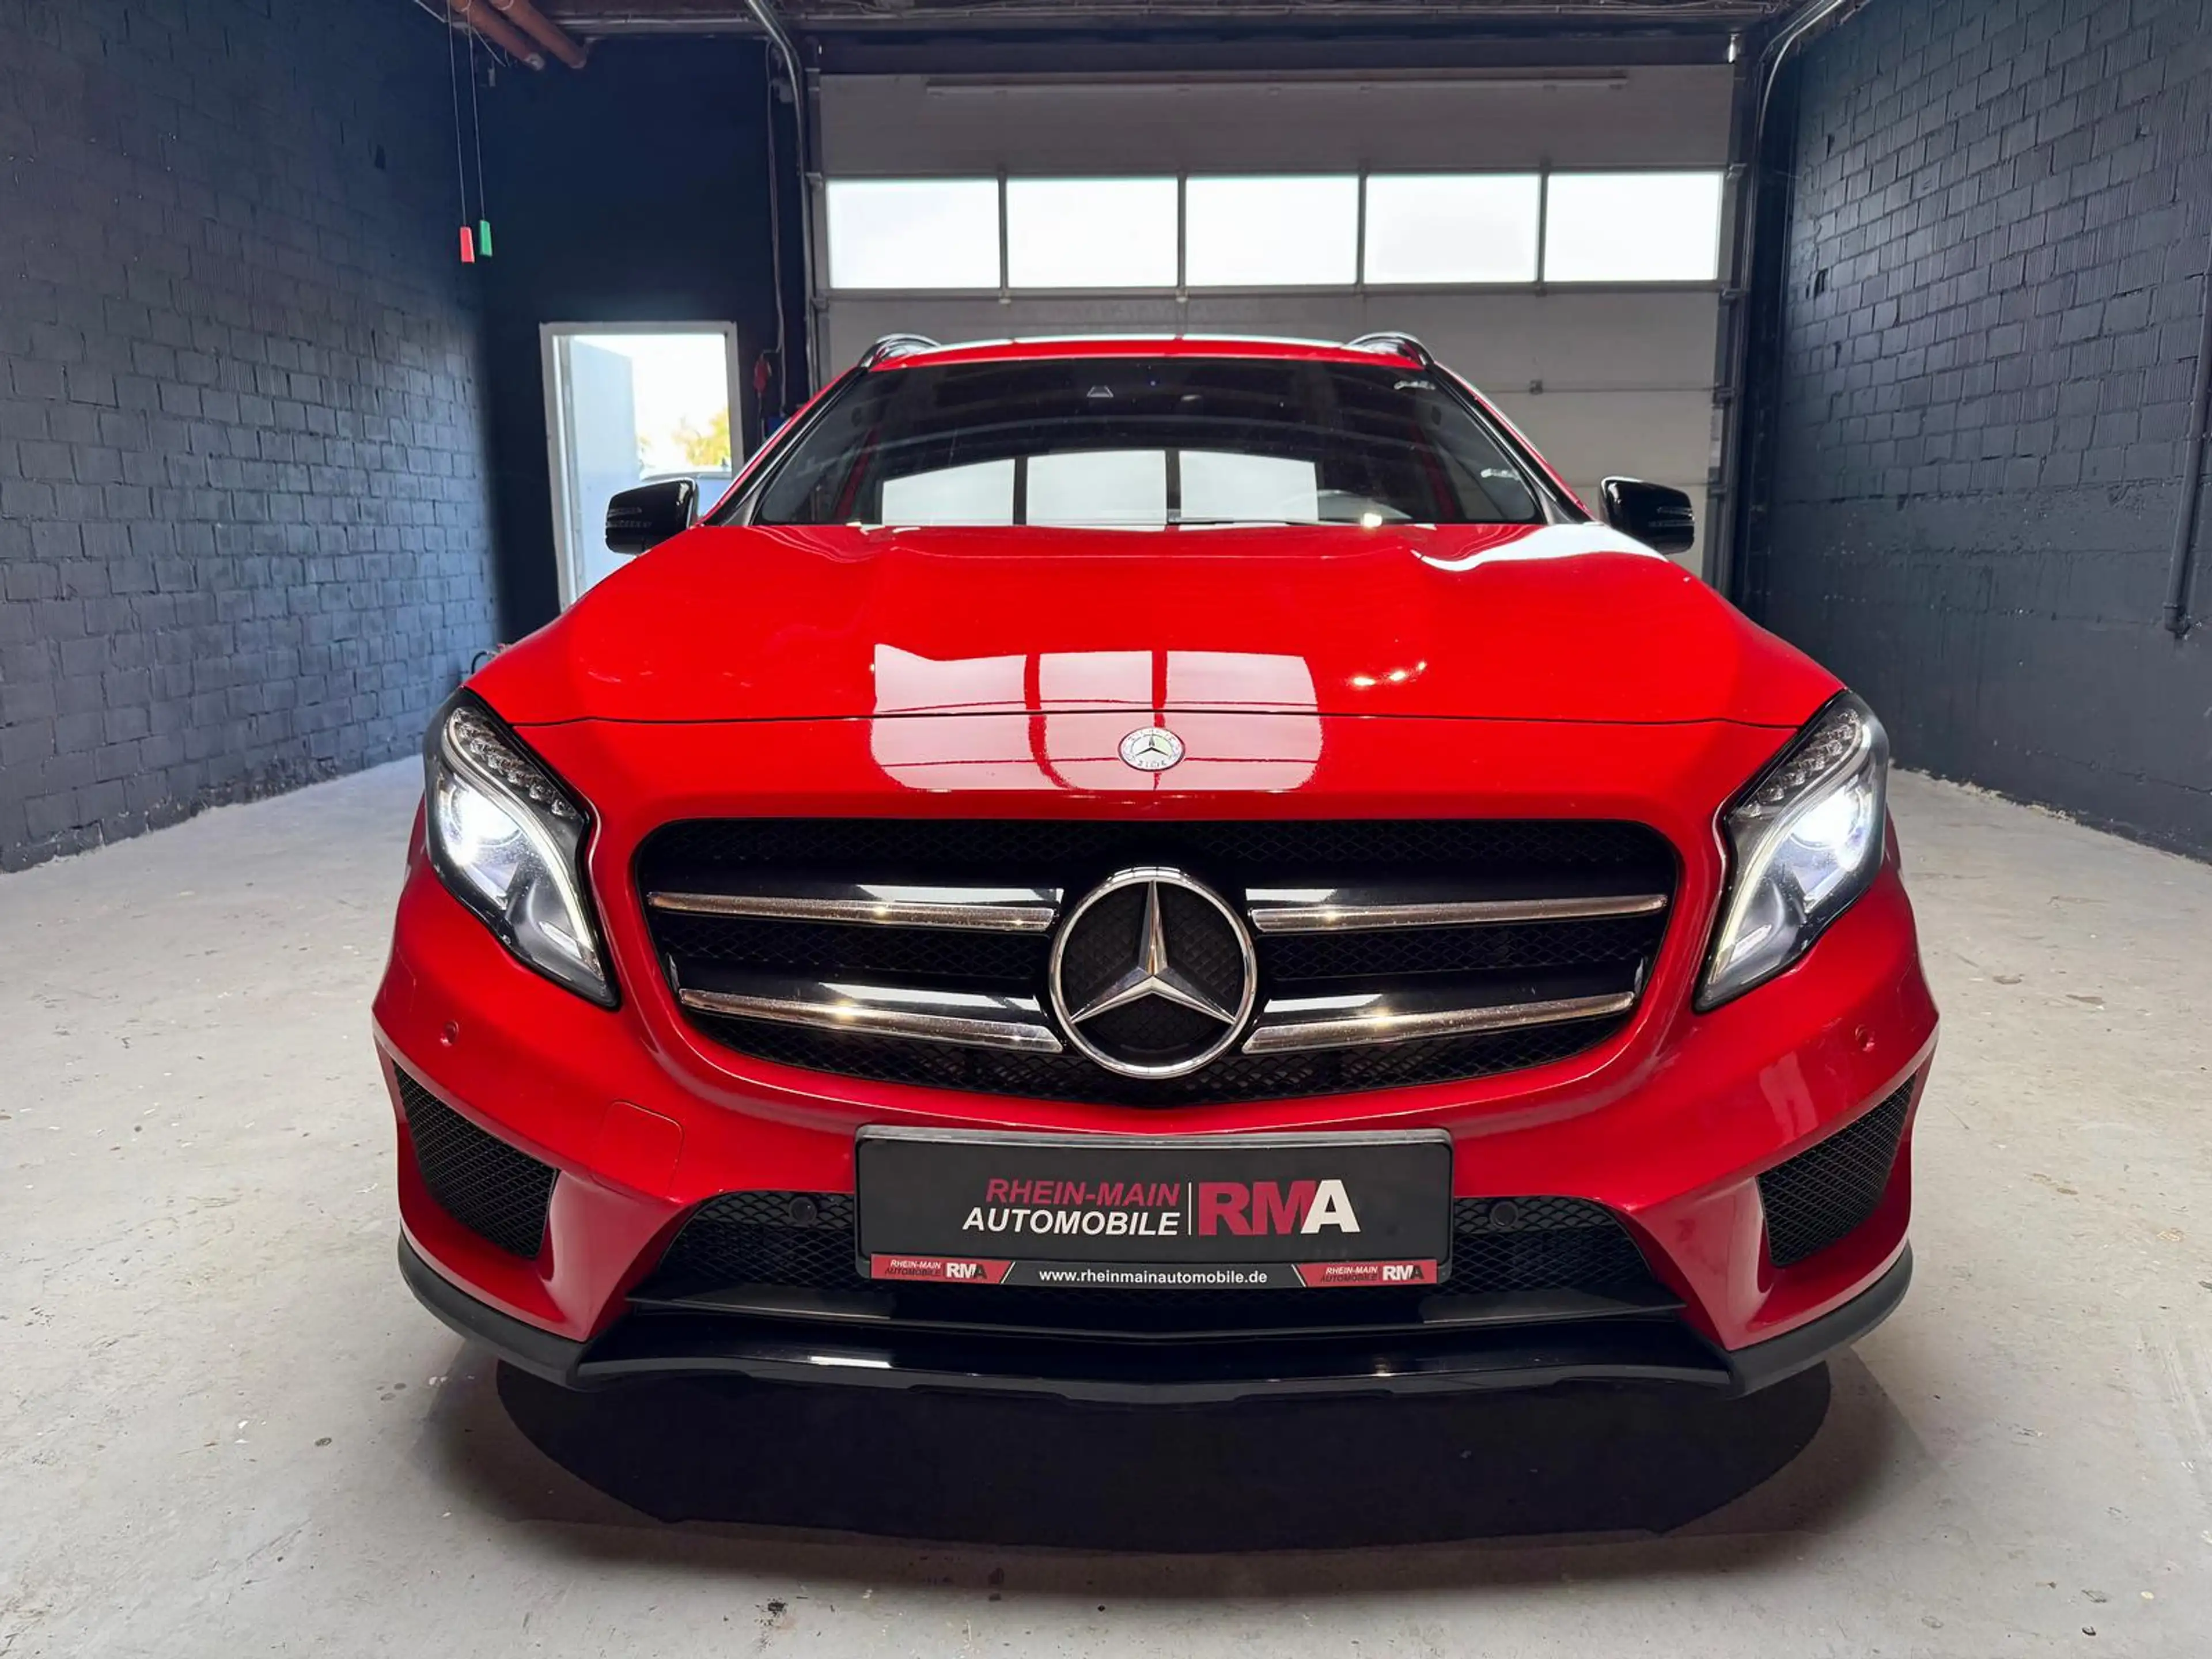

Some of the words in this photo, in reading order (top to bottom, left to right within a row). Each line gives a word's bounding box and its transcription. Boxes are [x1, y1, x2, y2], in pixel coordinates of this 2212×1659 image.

[986, 1179, 1181, 1206] RHEIN-MAIN
[1198, 1179, 1361, 1235] RMA
[962, 1207, 1181, 1236] AUTOMOBILE
[885, 1267, 941, 1277] AUTOMOBILE
[890, 1259, 941, 1269] RHEIN-MAIN
[946, 1262, 987, 1279] RMA
[1325, 1266, 1378, 1275] RHEIN-MAIN
[1039, 1269, 1267, 1284] www.rheinmainautomobile.de
[1382, 1265, 1425, 1281] RMA
